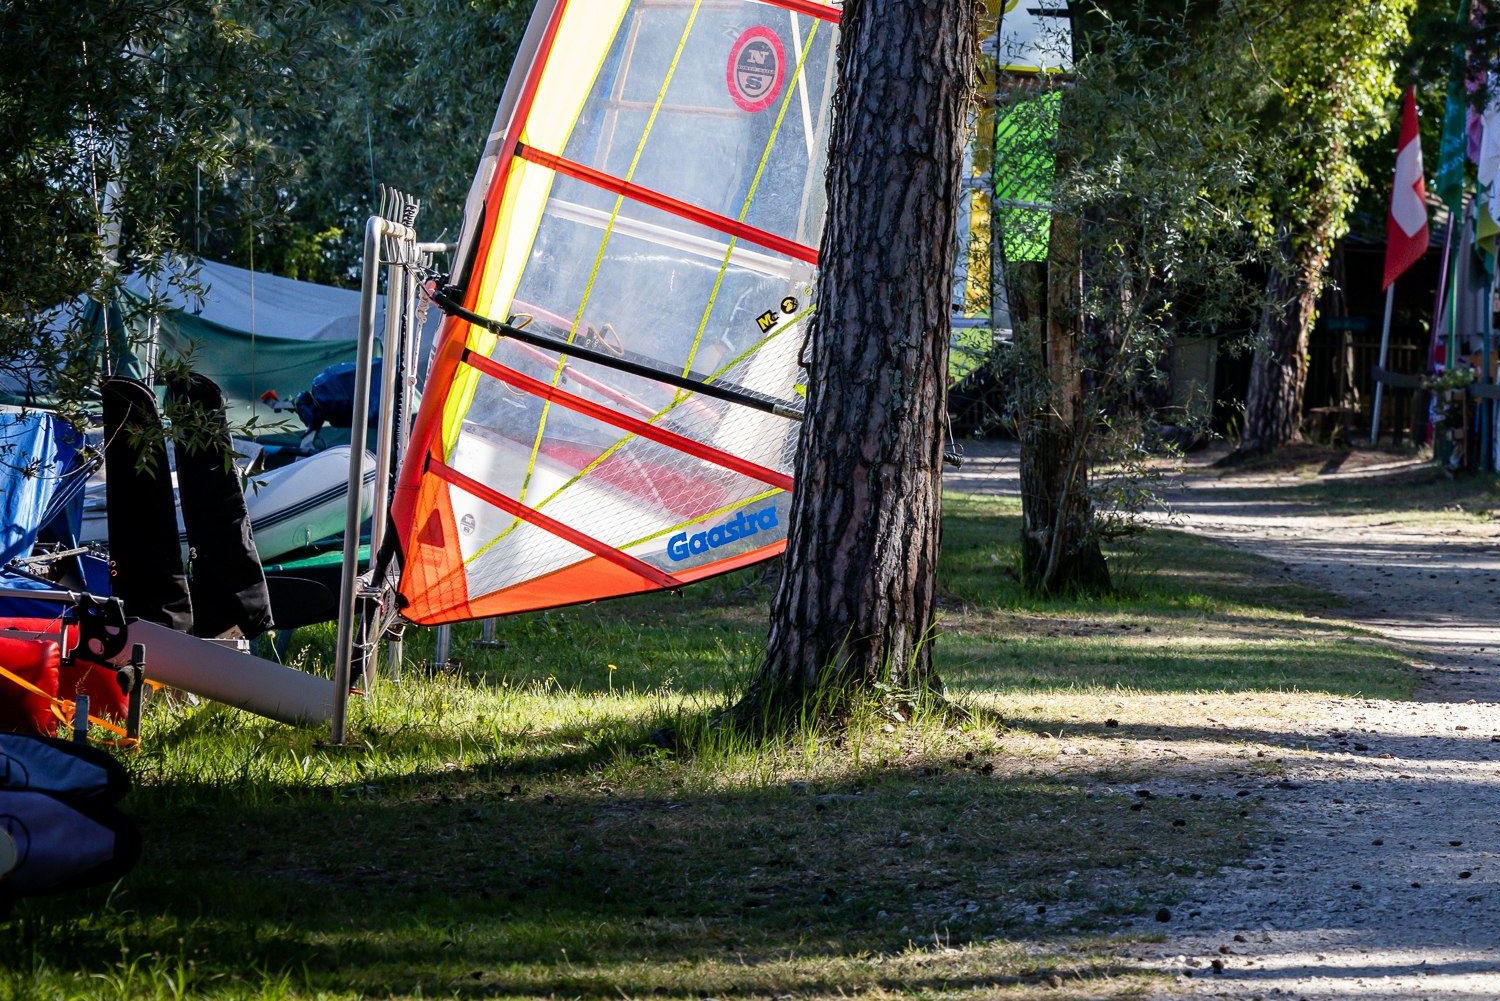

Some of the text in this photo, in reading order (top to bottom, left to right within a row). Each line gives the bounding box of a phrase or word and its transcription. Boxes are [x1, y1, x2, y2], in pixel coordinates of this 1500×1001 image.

[747, 49, 769, 65] N
[745, 75, 762, 90] S
[667, 505, 779, 562] Gaastra
